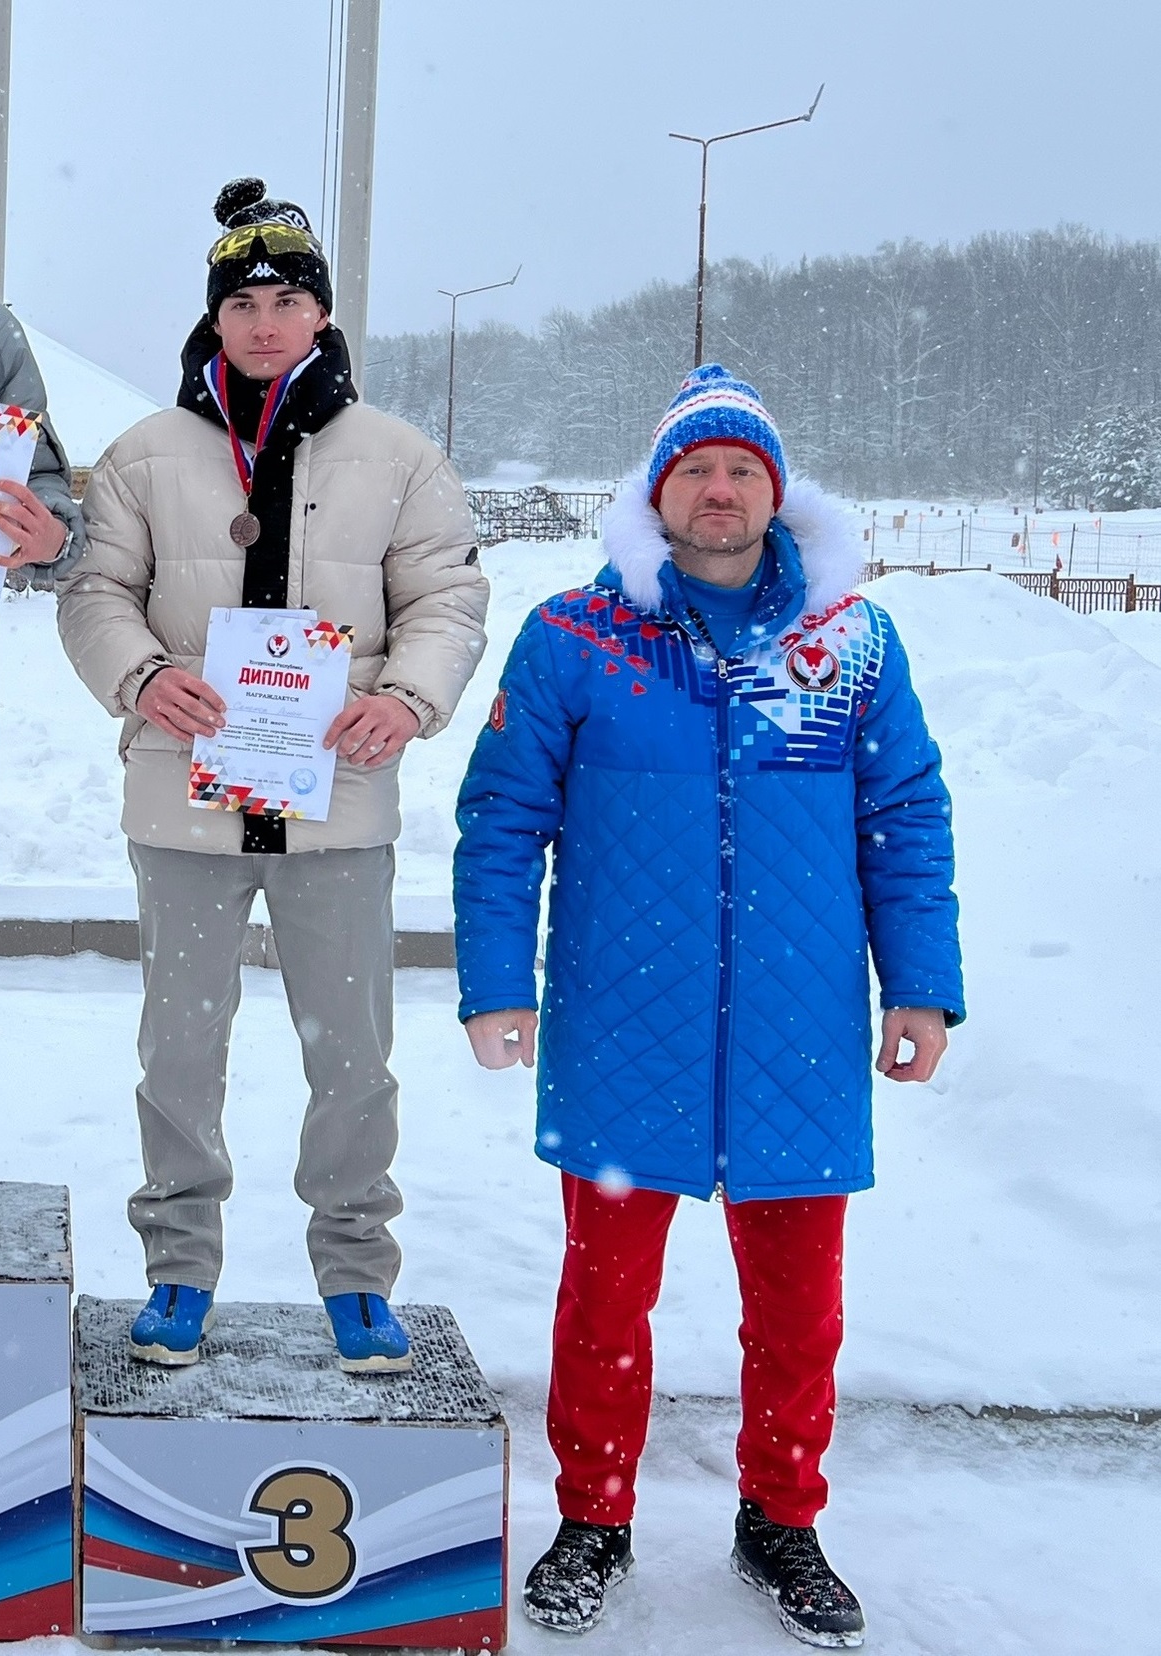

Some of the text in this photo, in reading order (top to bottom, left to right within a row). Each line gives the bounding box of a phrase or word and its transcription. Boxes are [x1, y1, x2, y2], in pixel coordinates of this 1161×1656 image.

[238, 667, 310, 690] ДИПЛОМ
[245, 691, 299, 703] НАГРАЖДАЕТСЯ
[243, 1466, 357, 1599] 3
